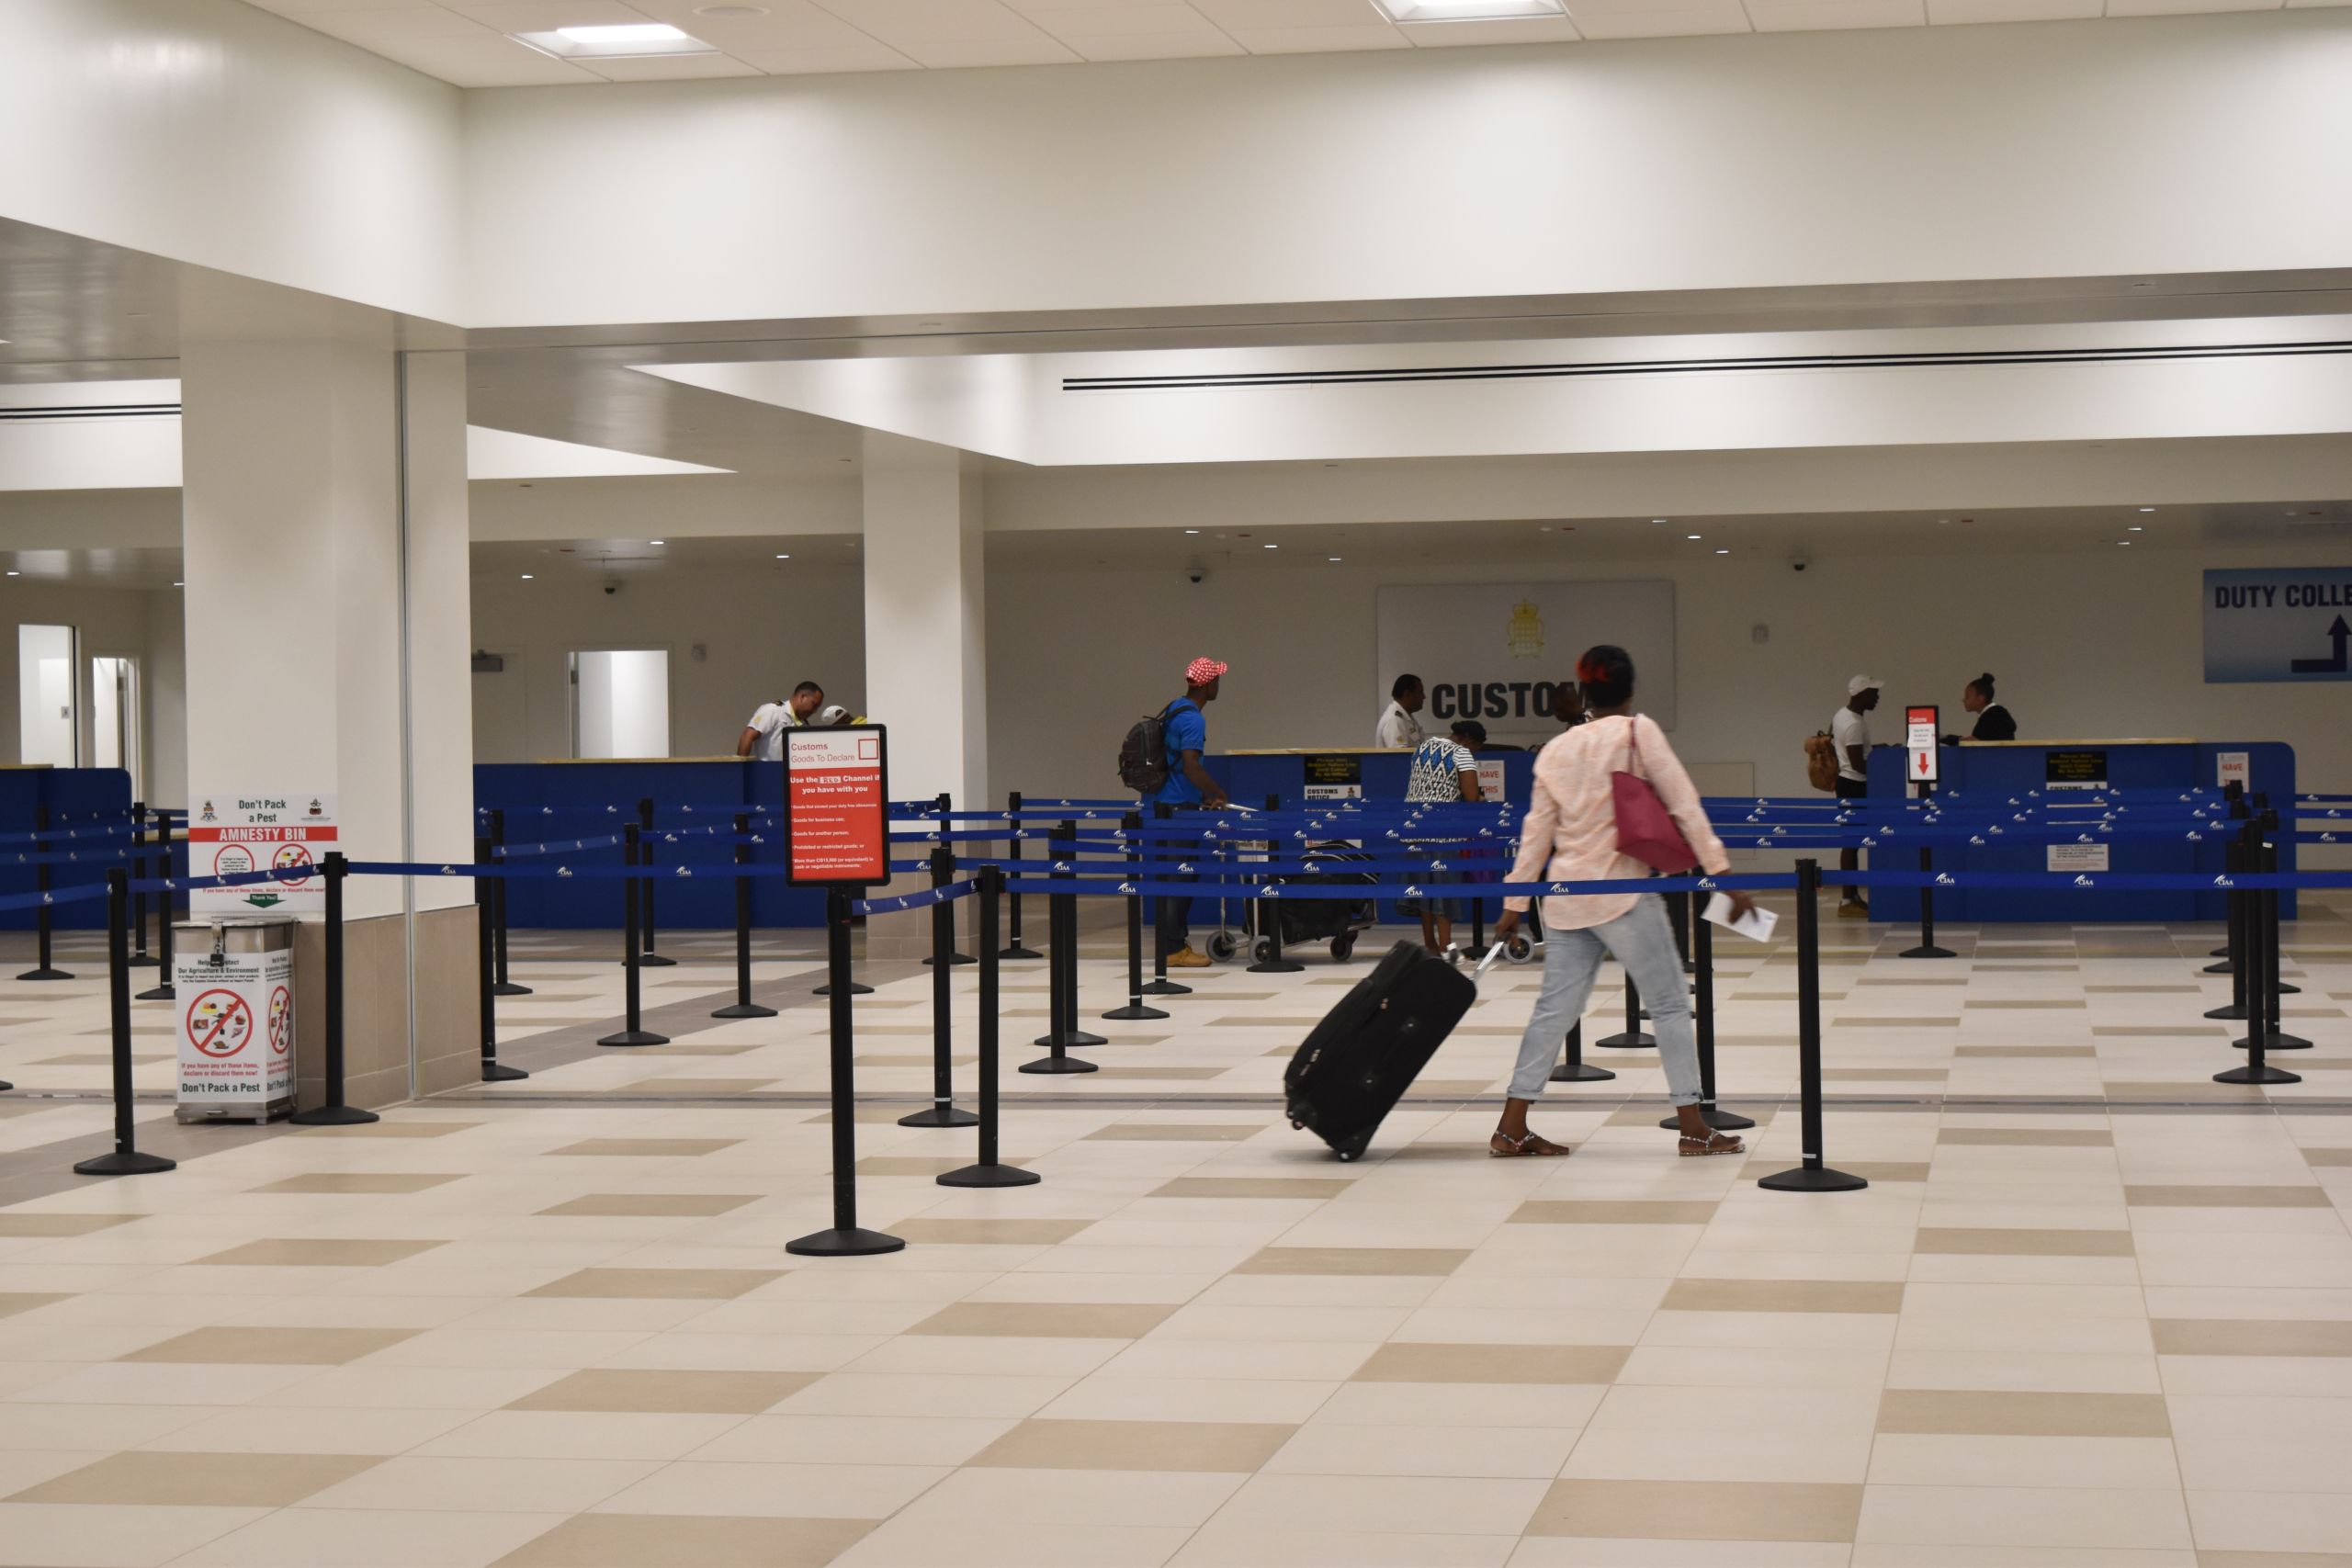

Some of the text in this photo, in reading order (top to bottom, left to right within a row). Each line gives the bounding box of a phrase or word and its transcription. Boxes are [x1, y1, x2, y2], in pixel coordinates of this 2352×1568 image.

[2215, 585, 2276, 608] DUTY
[791, 743, 828, 751] Customs
[791, 755, 815, 763] Goods
[827, 753, 855, 762] Declare
[2222, 763, 2243, 772] HAVE
[1479, 771, 1499, 779] HAVE
[239, 799, 287, 809] Don't Pack
[249, 813, 277, 823] a Pest
[219, 828, 307, 841] AMNESTY BIN
[182, 1082, 261, 1093] Don't Pack a Pest
